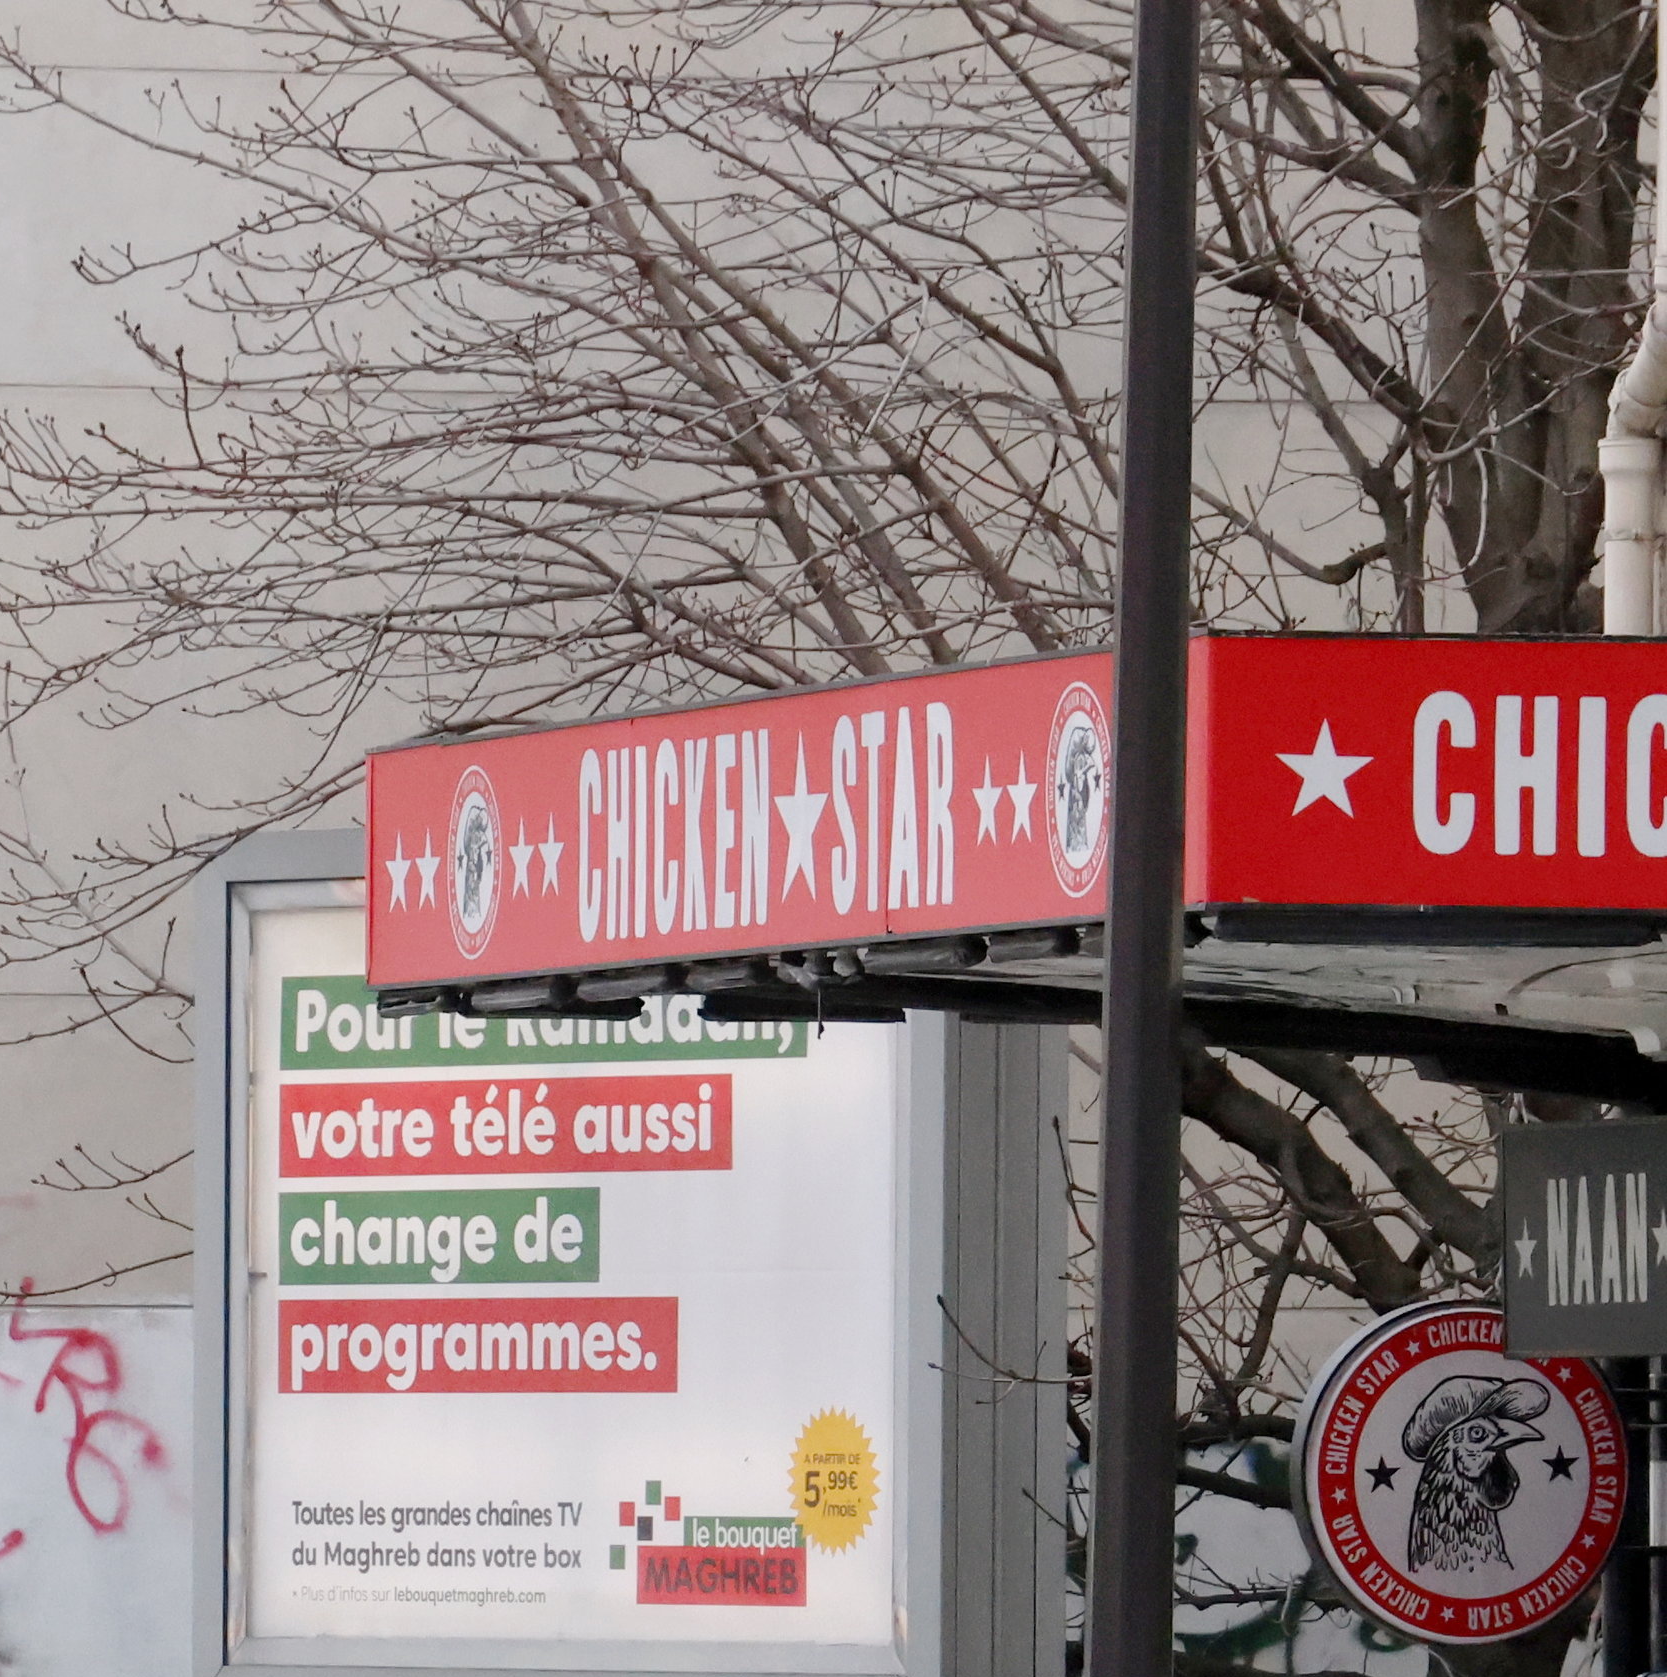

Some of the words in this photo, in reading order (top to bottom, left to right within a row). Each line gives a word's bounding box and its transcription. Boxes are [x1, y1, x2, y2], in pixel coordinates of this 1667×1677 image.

[578, 727, 769, 943] CHICKEN
[830, 701, 954, 916] STAR
[295, 990, 413, 1052] Pour
[438, 1003, 485, 1050] le
[291, 1097, 435, 1160] votre
[450, 1082, 556, 1157] télé
[573, 1082, 713, 1155] aussi
[290, 1199, 498, 1284] change
[513, 1196, 584, 1264] de
[1547, 1172, 1648, 1306] NAAN
[290, 1320, 658, 1392] programmes.
[1426, 1319, 1503, 1349] CHICKEN
[1325, 1395, 1366, 1476] CHICKEN
[1356, 1350, 1400, 1396] STAR
[1575, 1387, 1617, 1467] CHICKEN
[813, 1452, 846, 1465] PARTIR
[848, 1453, 861, 1465] DE
[803, 1470, 859, 1508] 5,99€
[1593, 1474, 1617, 1525] STAR
[292, 1500, 354, 1526] Toutes
[359, 1500, 386, 1526] les
[391, 1500, 472, 1533] grandes
[476, 1499, 553, 1527] chaînes
[557, 1502, 583, 1527] TV
[692, 1517, 710, 1548] le
[715, 1517, 798, 1556] bouquet
[1332, 1513, 1367, 1563] STAR
[292, 1541, 317, 1567] du
[323, 1541, 421, 1574] Maghreb
[426, 1541, 476, 1568] dans
[482, 1545, 537, 1568] votre
[543, 1543, 582, 1569] box
[644, 1557, 799, 1595] MAGHREB
[301, 1585, 325, 1603] Plus
[327, 1585, 369, 1603] d'infos
[372, 1589, 393, 1603] sur
[393, 1587, 546, 1607] lebouquetmaghreb.com
[1361, 1559, 1430, 1621] CHICKEN
[1519, 1554, 1588, 1617] CHICKEN
[1467, 1602, 1514, 1631] STAR
